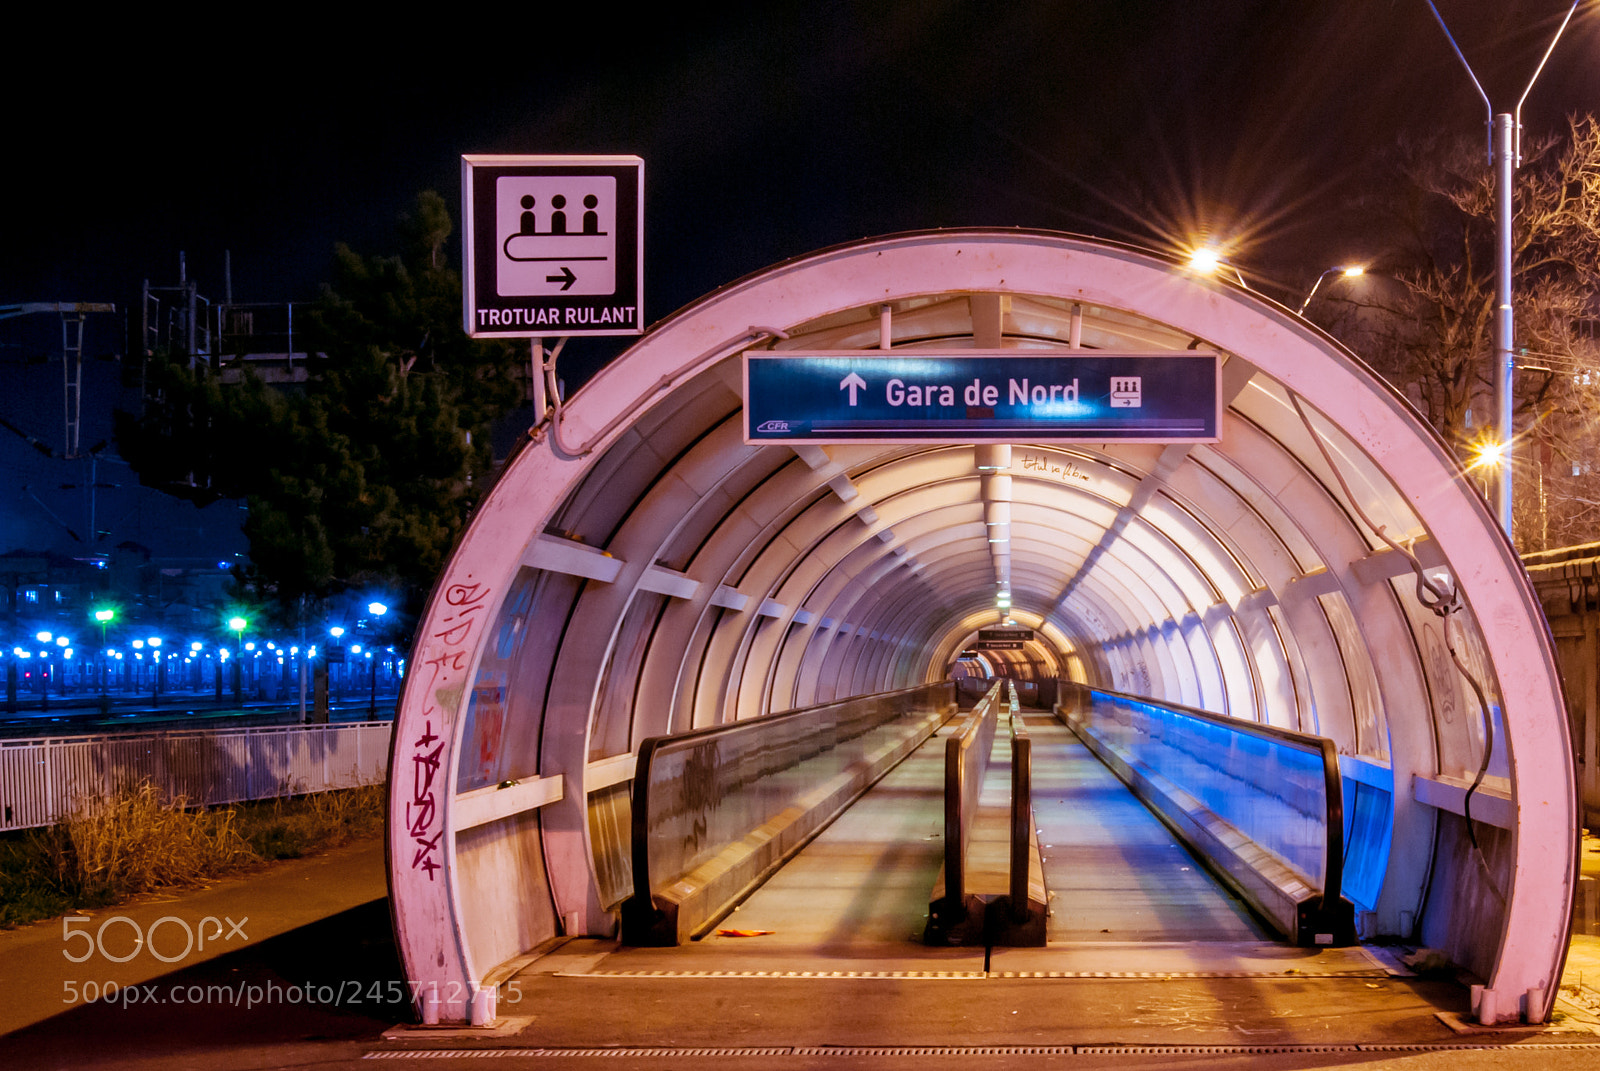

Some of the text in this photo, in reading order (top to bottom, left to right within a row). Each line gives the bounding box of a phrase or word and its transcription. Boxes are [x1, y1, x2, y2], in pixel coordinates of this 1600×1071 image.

[478, 307, 635, 325] TROTUAR RULANT
[886, 378, 1079, 407] Gara de Nord
[767, 422, 789, 430] CFR
